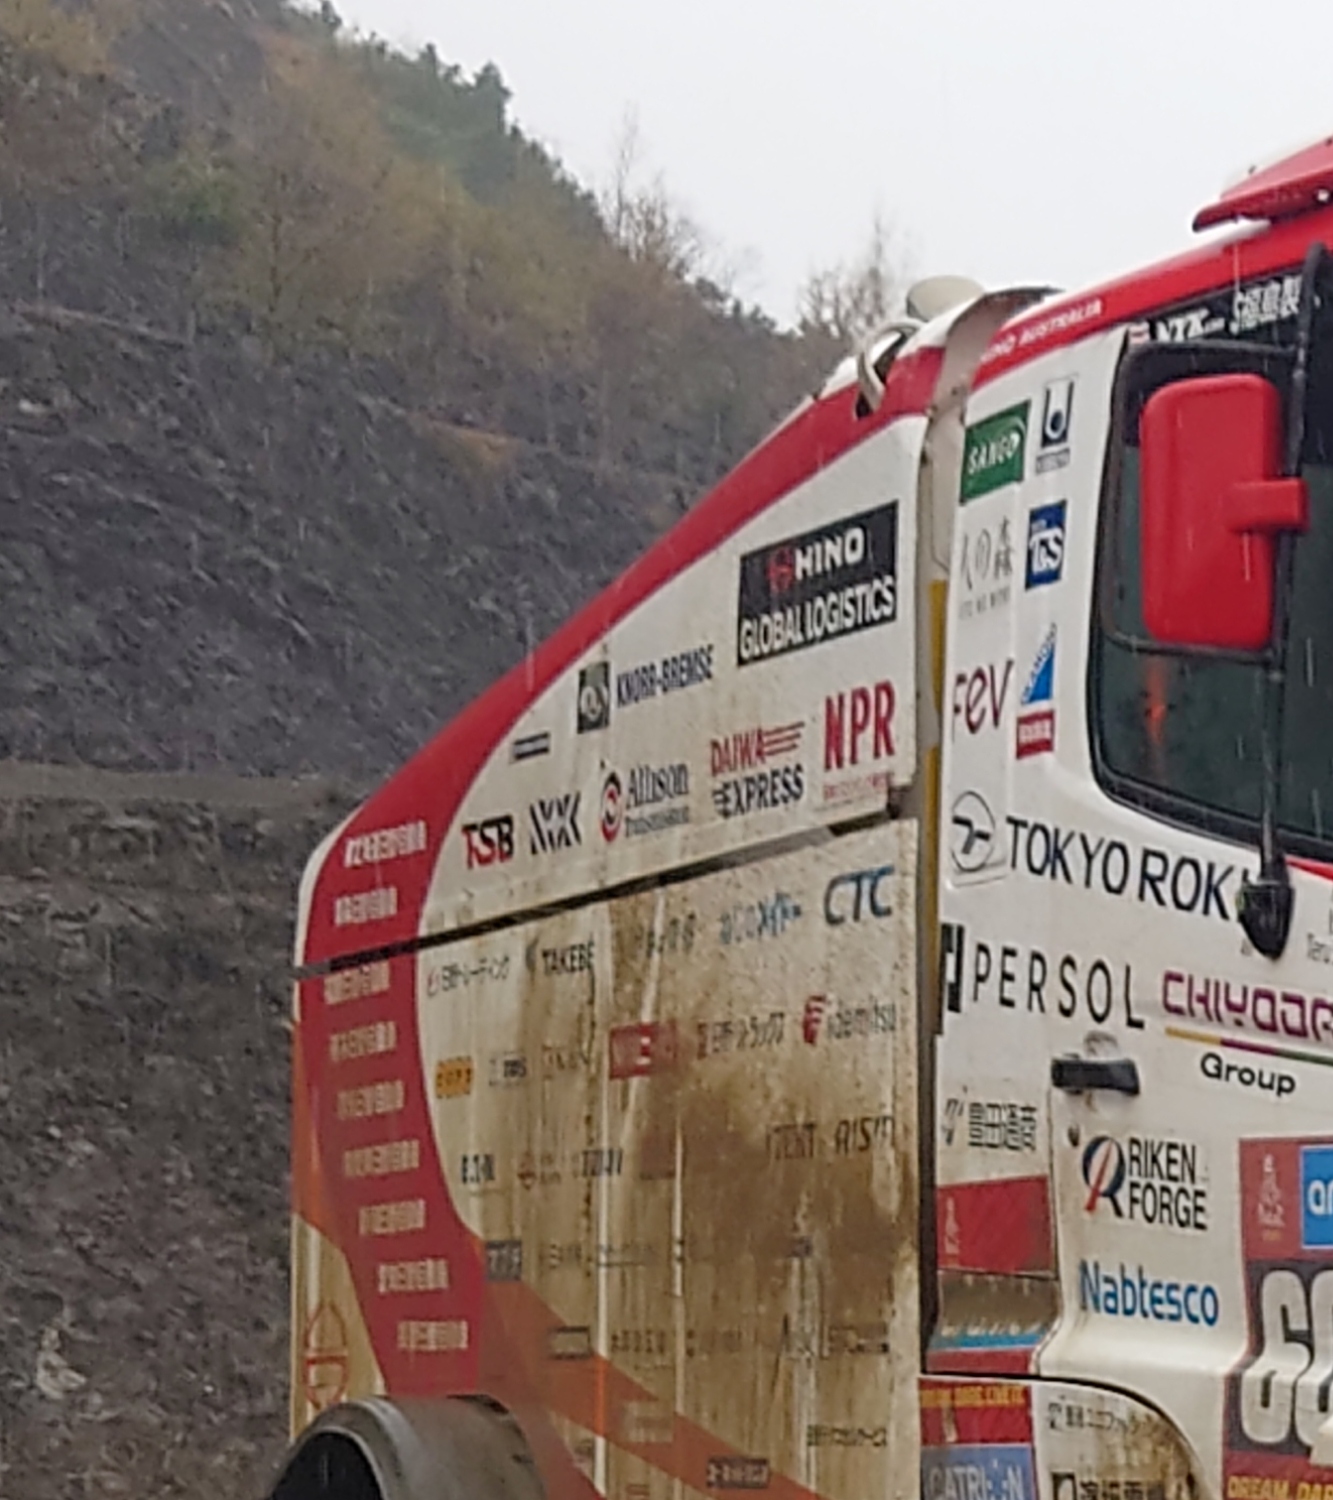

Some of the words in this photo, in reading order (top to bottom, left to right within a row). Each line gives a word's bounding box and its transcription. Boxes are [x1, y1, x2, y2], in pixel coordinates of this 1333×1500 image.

[795, 526, 865, 580] HINO
[739, 603, 805, 660] GLOBAL
[805, 574, 895, 642] LOGISTICS
[616, 644, 714, 707] KNORR-BREMSE
[710, 727, 766, 776] DAIWA
[823, 681, 896, 772] NPR
[627, 763, 689, 807] Allison
[822, 866, 895, 926] CTC
[1006, 815, 1130, 896] TOKYO
[1137, 847, 1250, 923] ROK
[972, 943, 1145, 1030] PERSOL
[1200, 1052, 1296, 1097] Group
[1128, 1136, 1197, 1185] RIKEN
[1128, 1181, 1208, 1231] FORGE
[1080, 1259, 1219, 1326] Nabtesco
